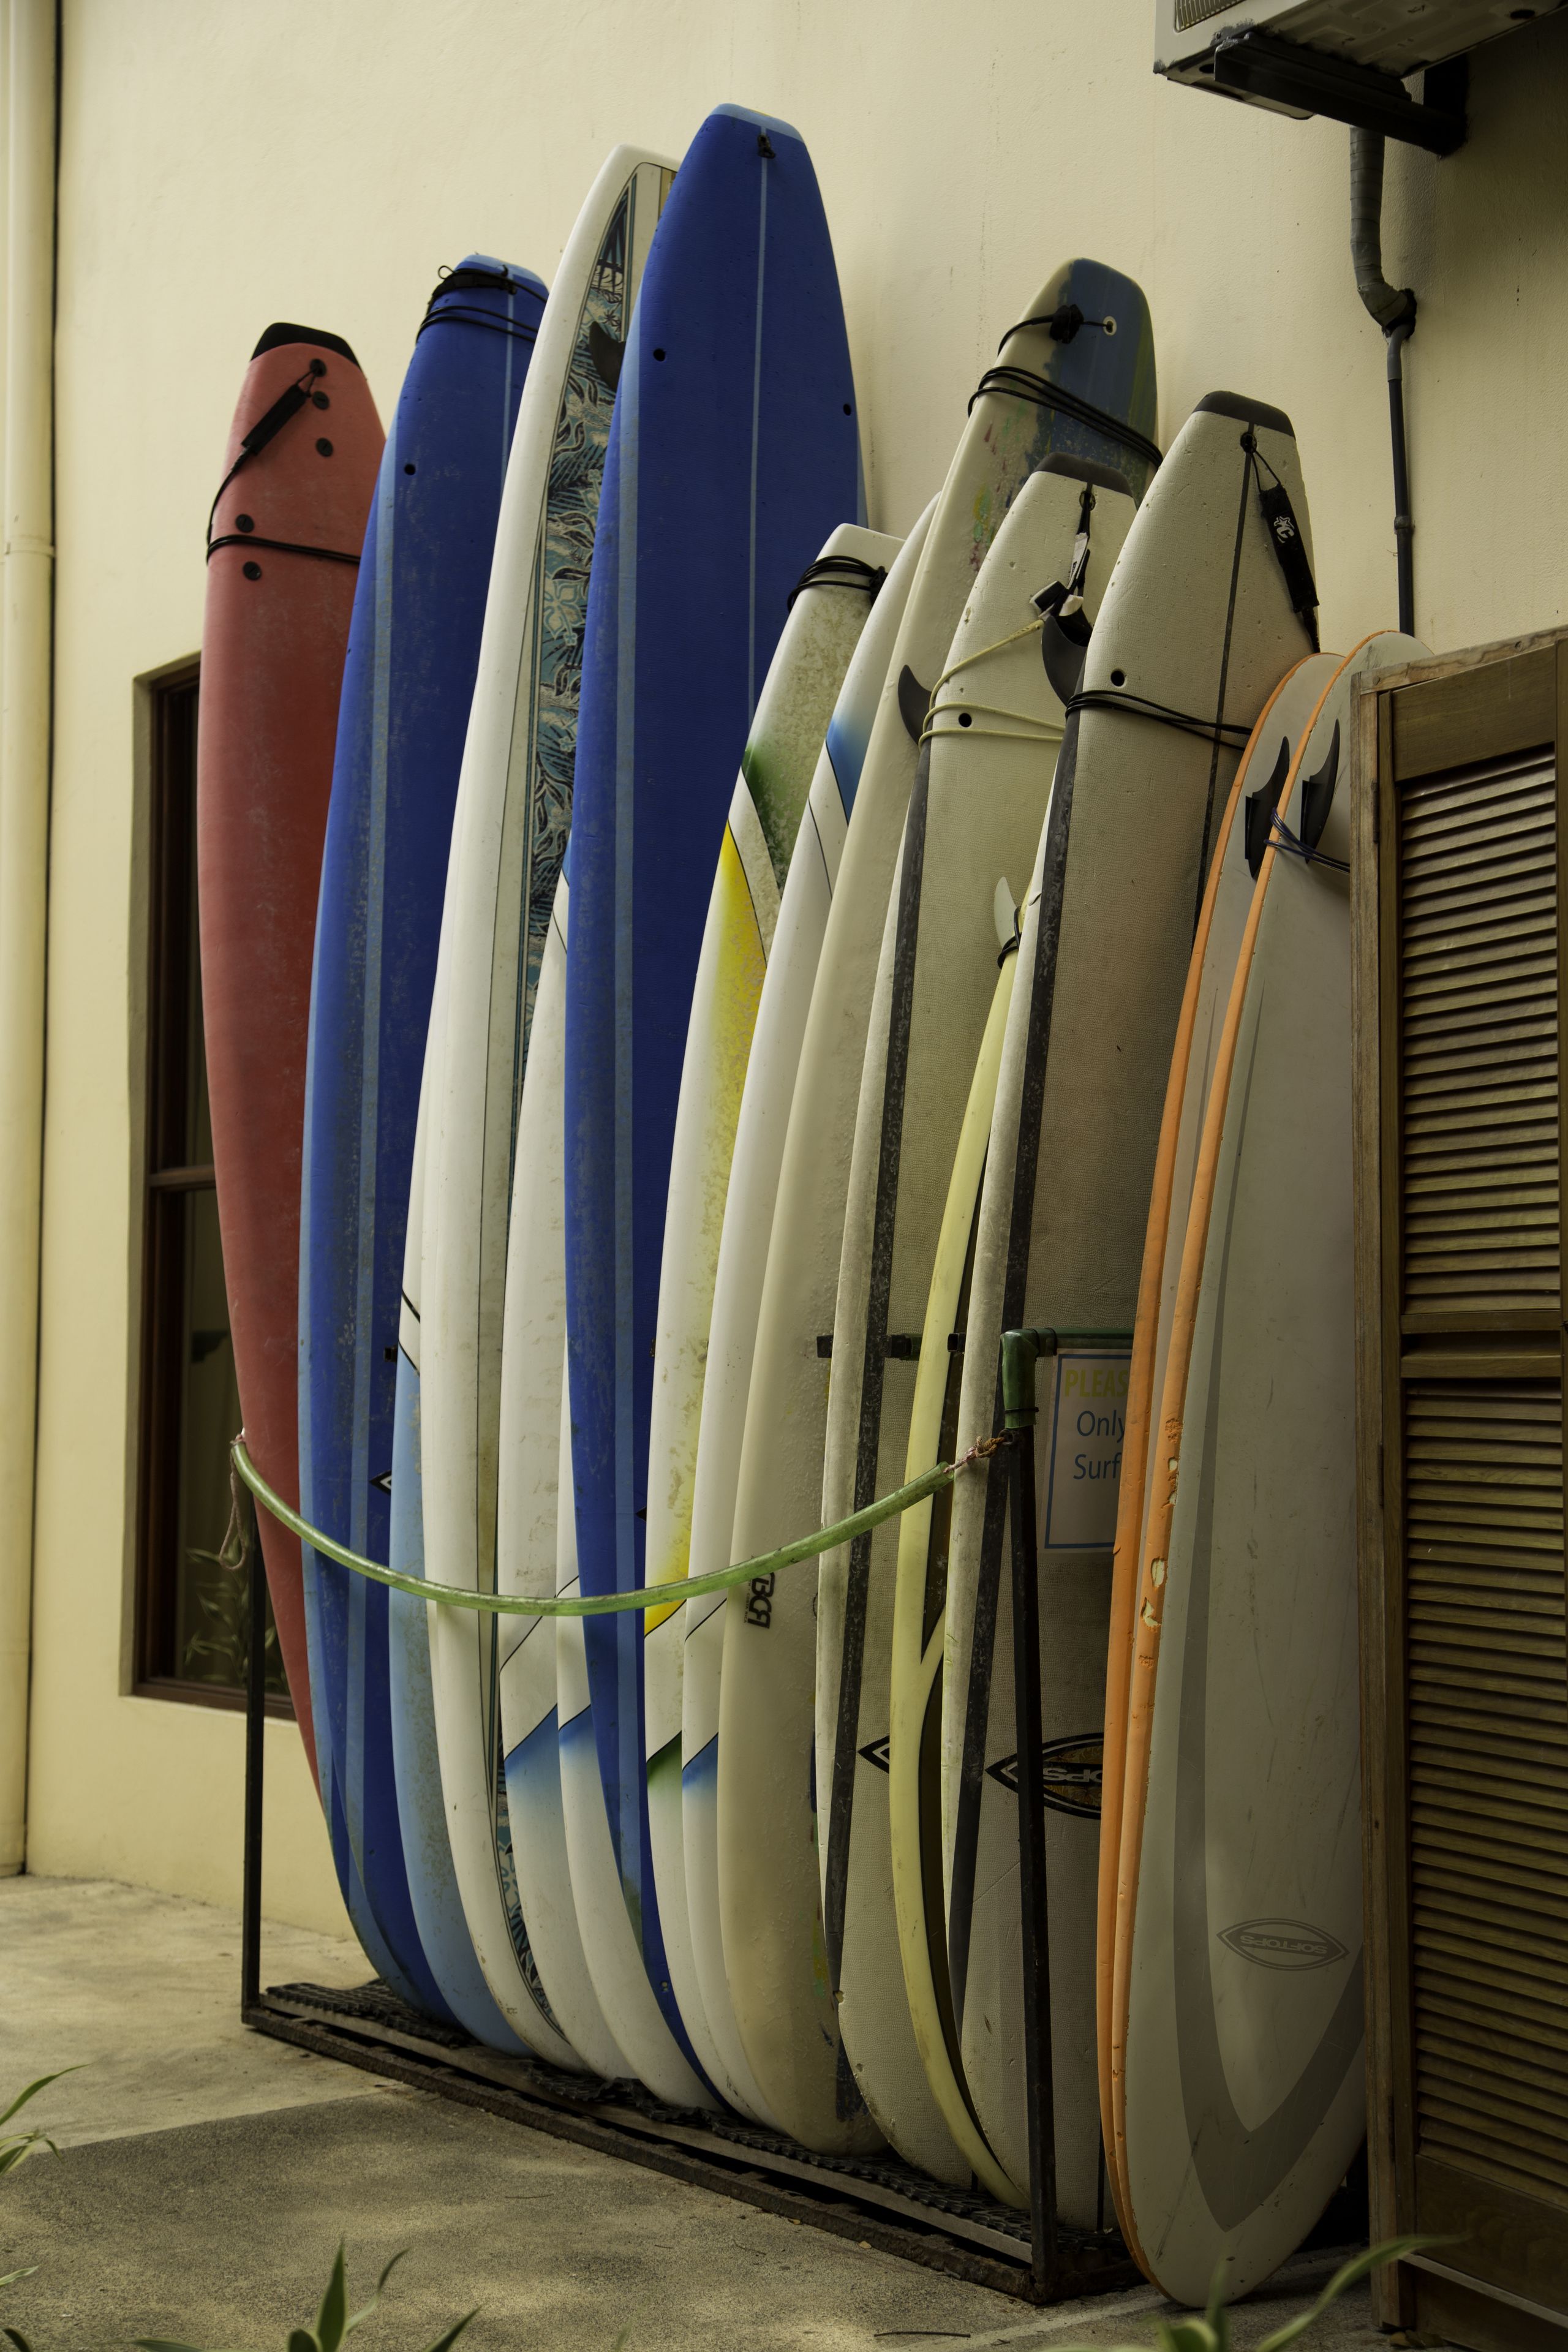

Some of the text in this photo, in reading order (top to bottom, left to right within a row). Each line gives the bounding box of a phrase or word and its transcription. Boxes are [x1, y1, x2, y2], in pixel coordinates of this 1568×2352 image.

[1077, 1409, 1125, 1442] Only
[1073, 1452, 1122, 1480] Surf
[1240, 1935, 1329, 1954] SOFTOPS
